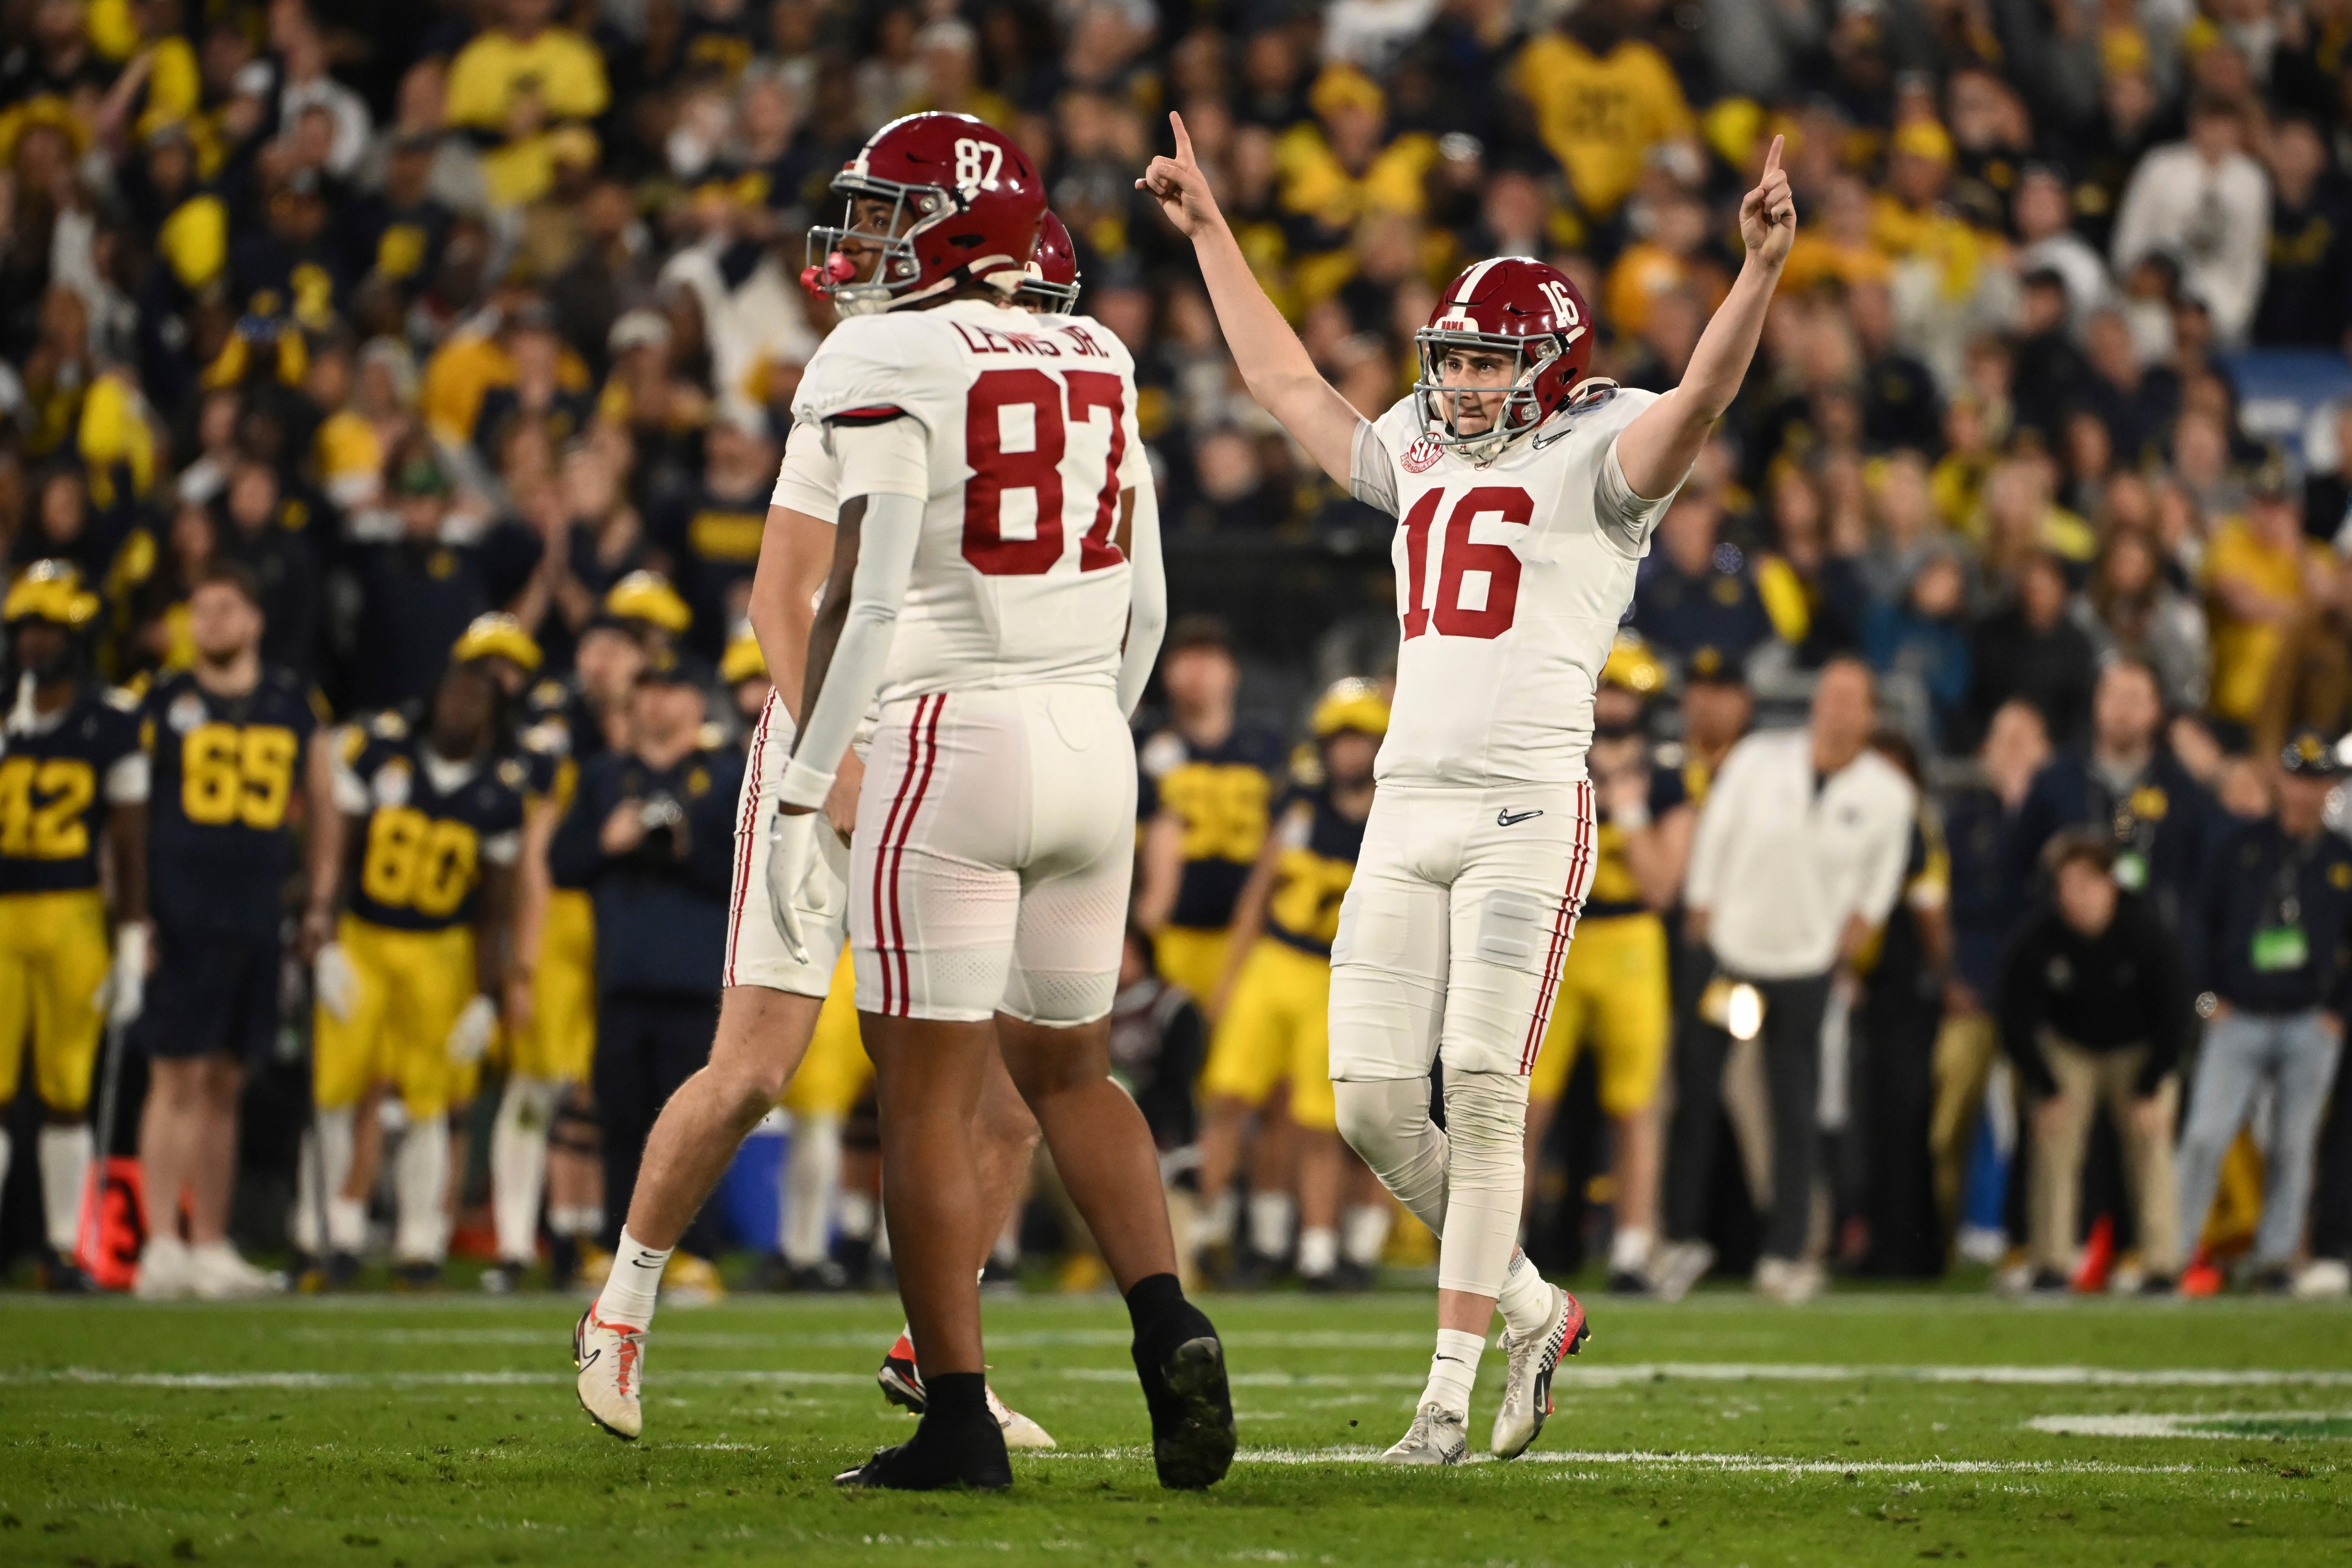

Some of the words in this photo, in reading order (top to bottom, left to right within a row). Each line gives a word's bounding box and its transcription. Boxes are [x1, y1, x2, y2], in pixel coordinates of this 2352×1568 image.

[955, 137, 1003, 192] 87
[1441, 321, 1464, 331] BAMA
[1538, 280, 1579, 328] 16
[951, 321, 1061, 357] LEWIS
[961, 368, 1126, 575] 87
[1403, 458, 1435, 471] GRADUATE
[1401, 486, 1535, 642] 16
[181, 722, 298, 831] 65
